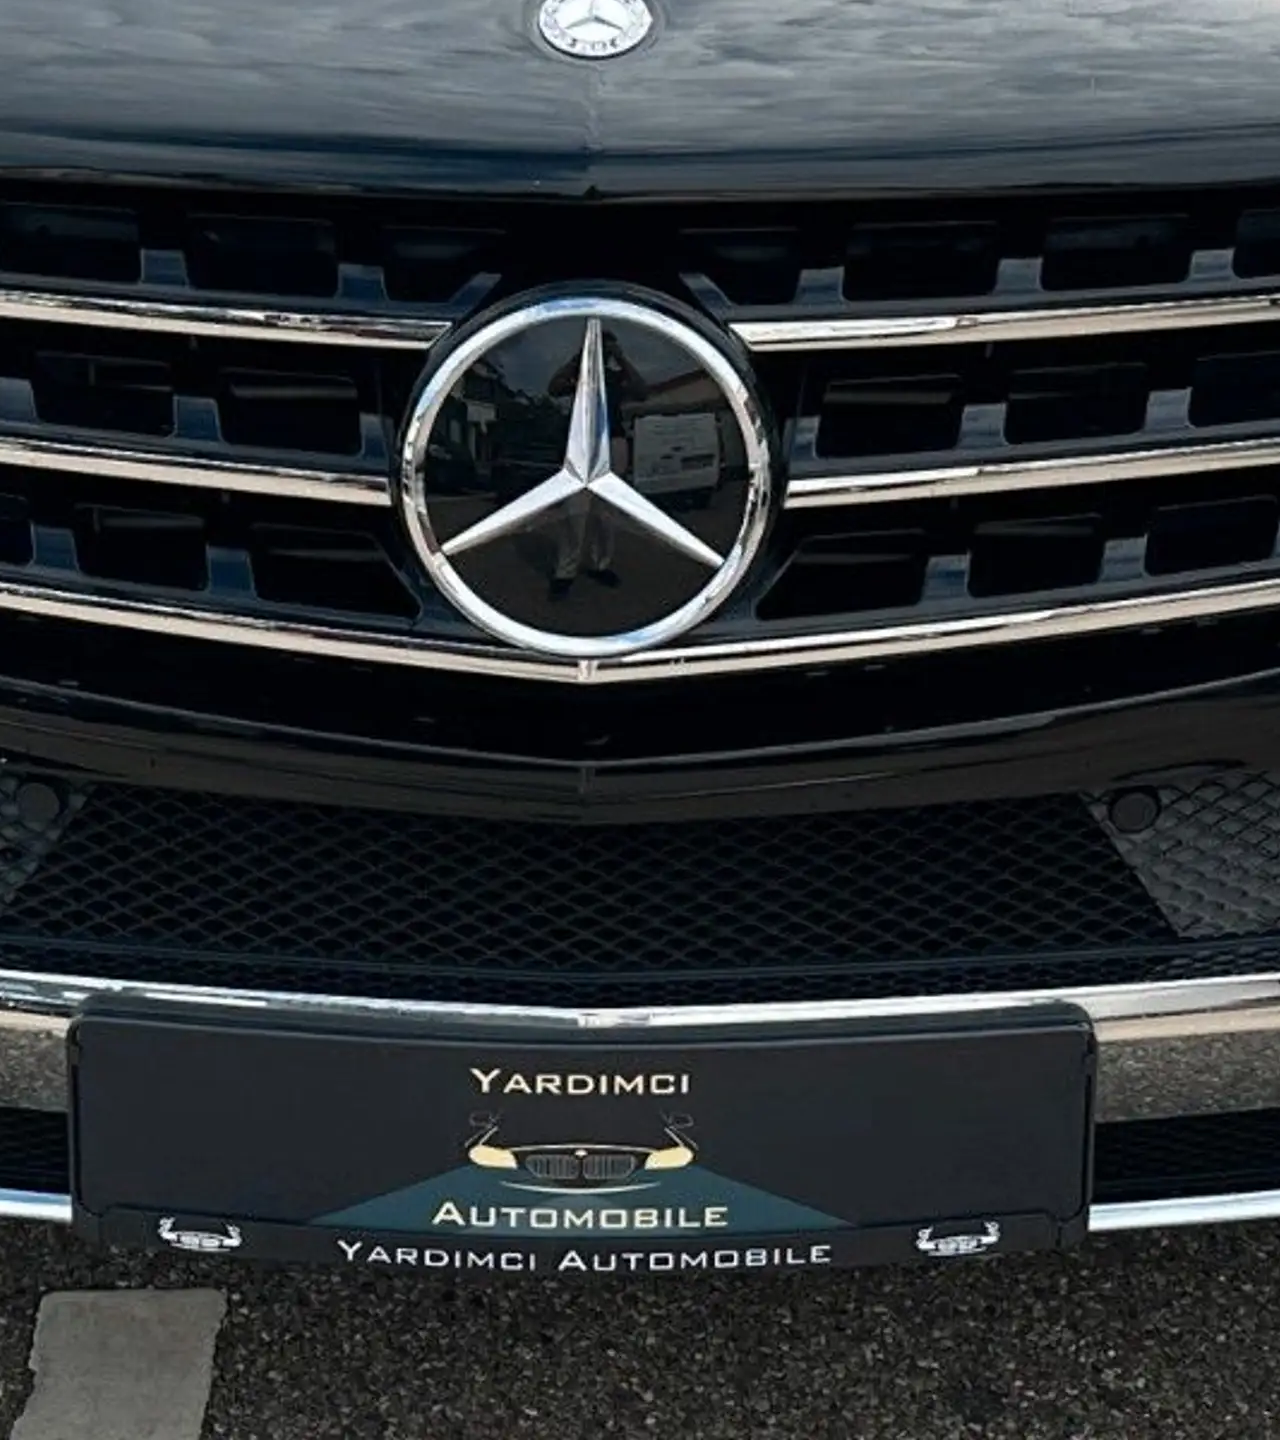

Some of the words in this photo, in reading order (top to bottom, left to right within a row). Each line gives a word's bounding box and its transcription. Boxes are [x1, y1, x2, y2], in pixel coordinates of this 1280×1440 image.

[470, 1067, 690, 1095] YARDIMCI
[432, 1201, 730, 1230] AUTOMOBILE
[337, 1239, 536, 1271] YARDIMCI
[558, 1245, 832, 1272] AUTOMOBILE
